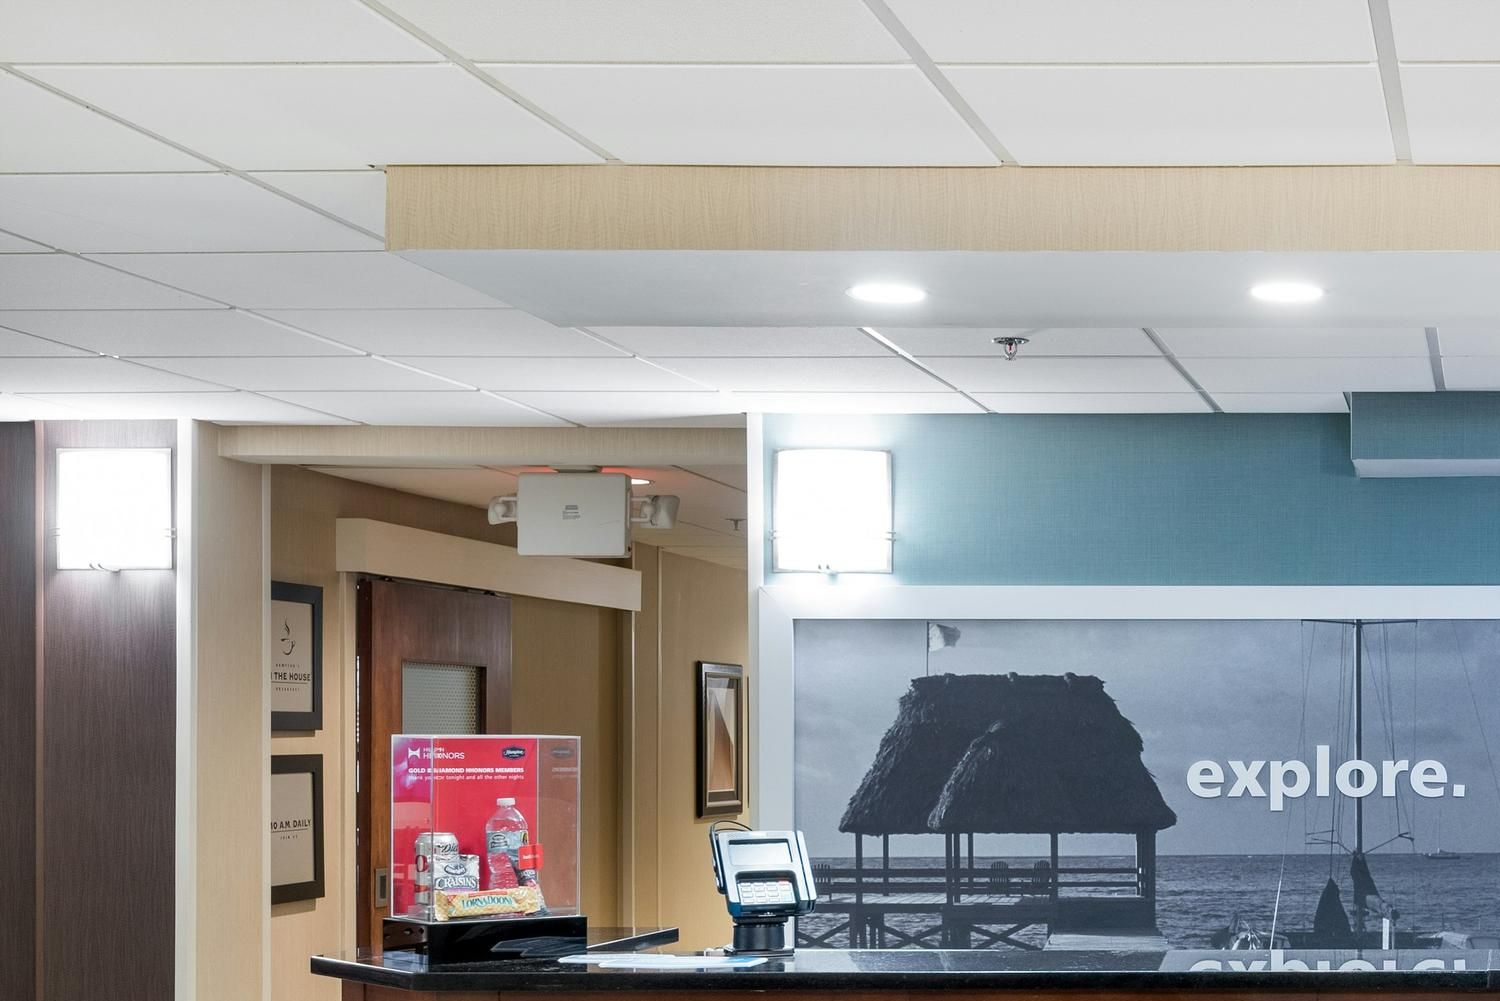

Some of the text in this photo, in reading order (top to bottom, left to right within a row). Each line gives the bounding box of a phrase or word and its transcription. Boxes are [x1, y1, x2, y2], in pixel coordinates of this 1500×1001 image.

[274, 671, 311, 682] THE HOUSE
[1186, 744, 1467, 812] explore.
[292, 819, 311, 828] DAILY
